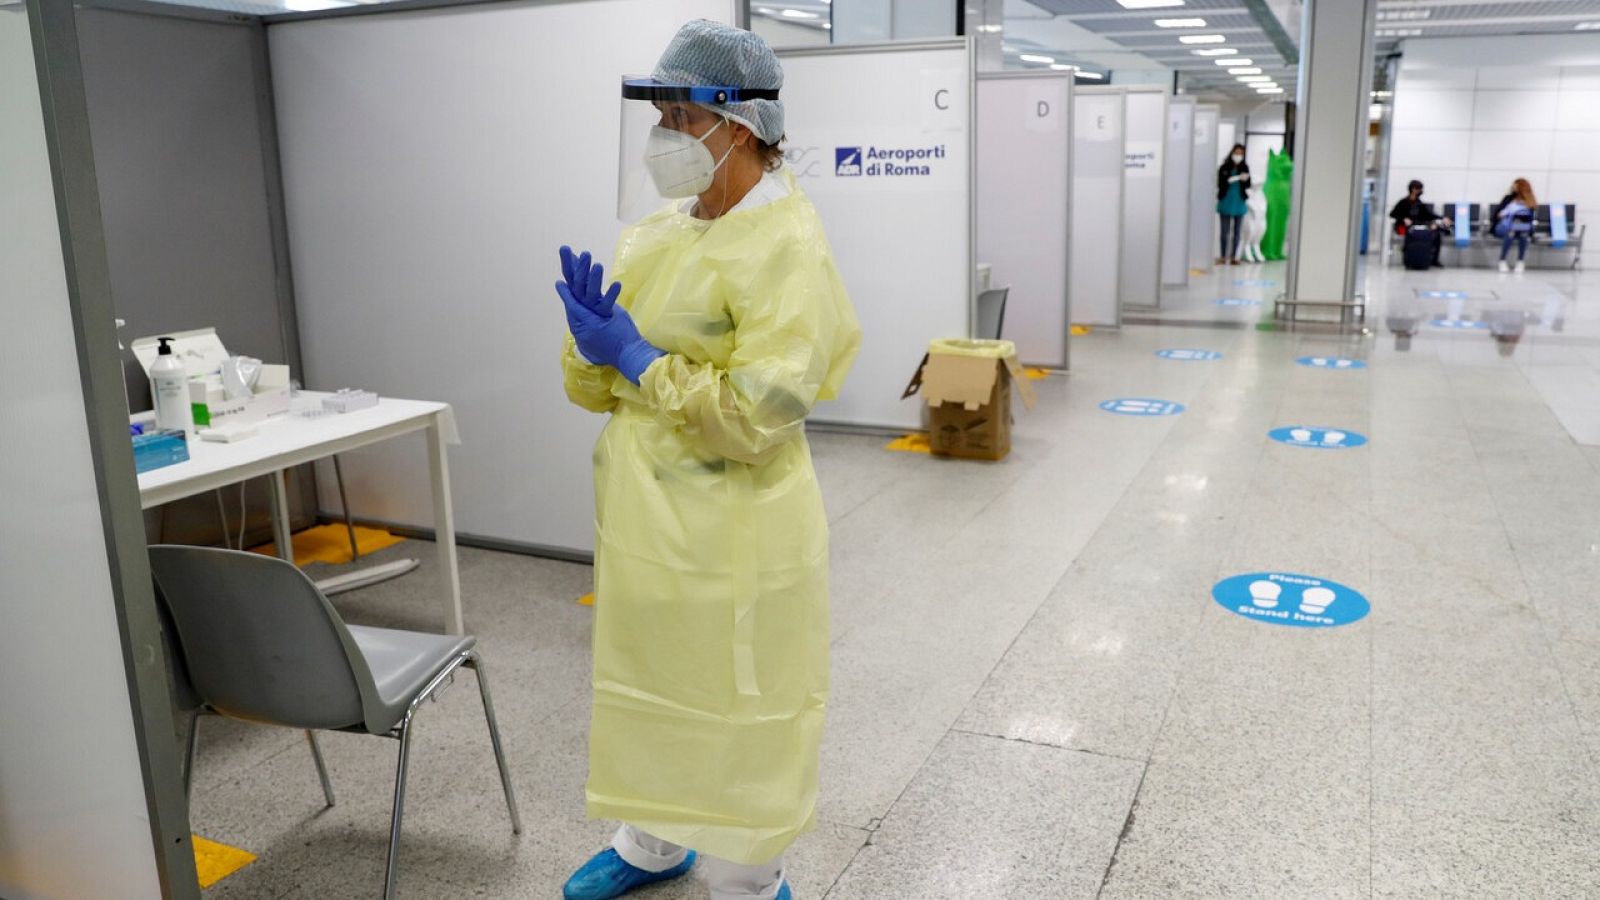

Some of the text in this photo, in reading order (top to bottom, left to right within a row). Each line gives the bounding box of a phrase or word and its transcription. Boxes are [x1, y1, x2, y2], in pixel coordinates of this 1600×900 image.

[934, 89, 949, 110] C
[1037, 100, 1050, 117] D
[1097, 115, 1105, 130] E
[866, 145, 945, 162] Aeroporti
[866, 163, 930, 176] di Roma
[1269, 574, 1321, 585] Please
[1238, 605, 1335, 624] Stand here
